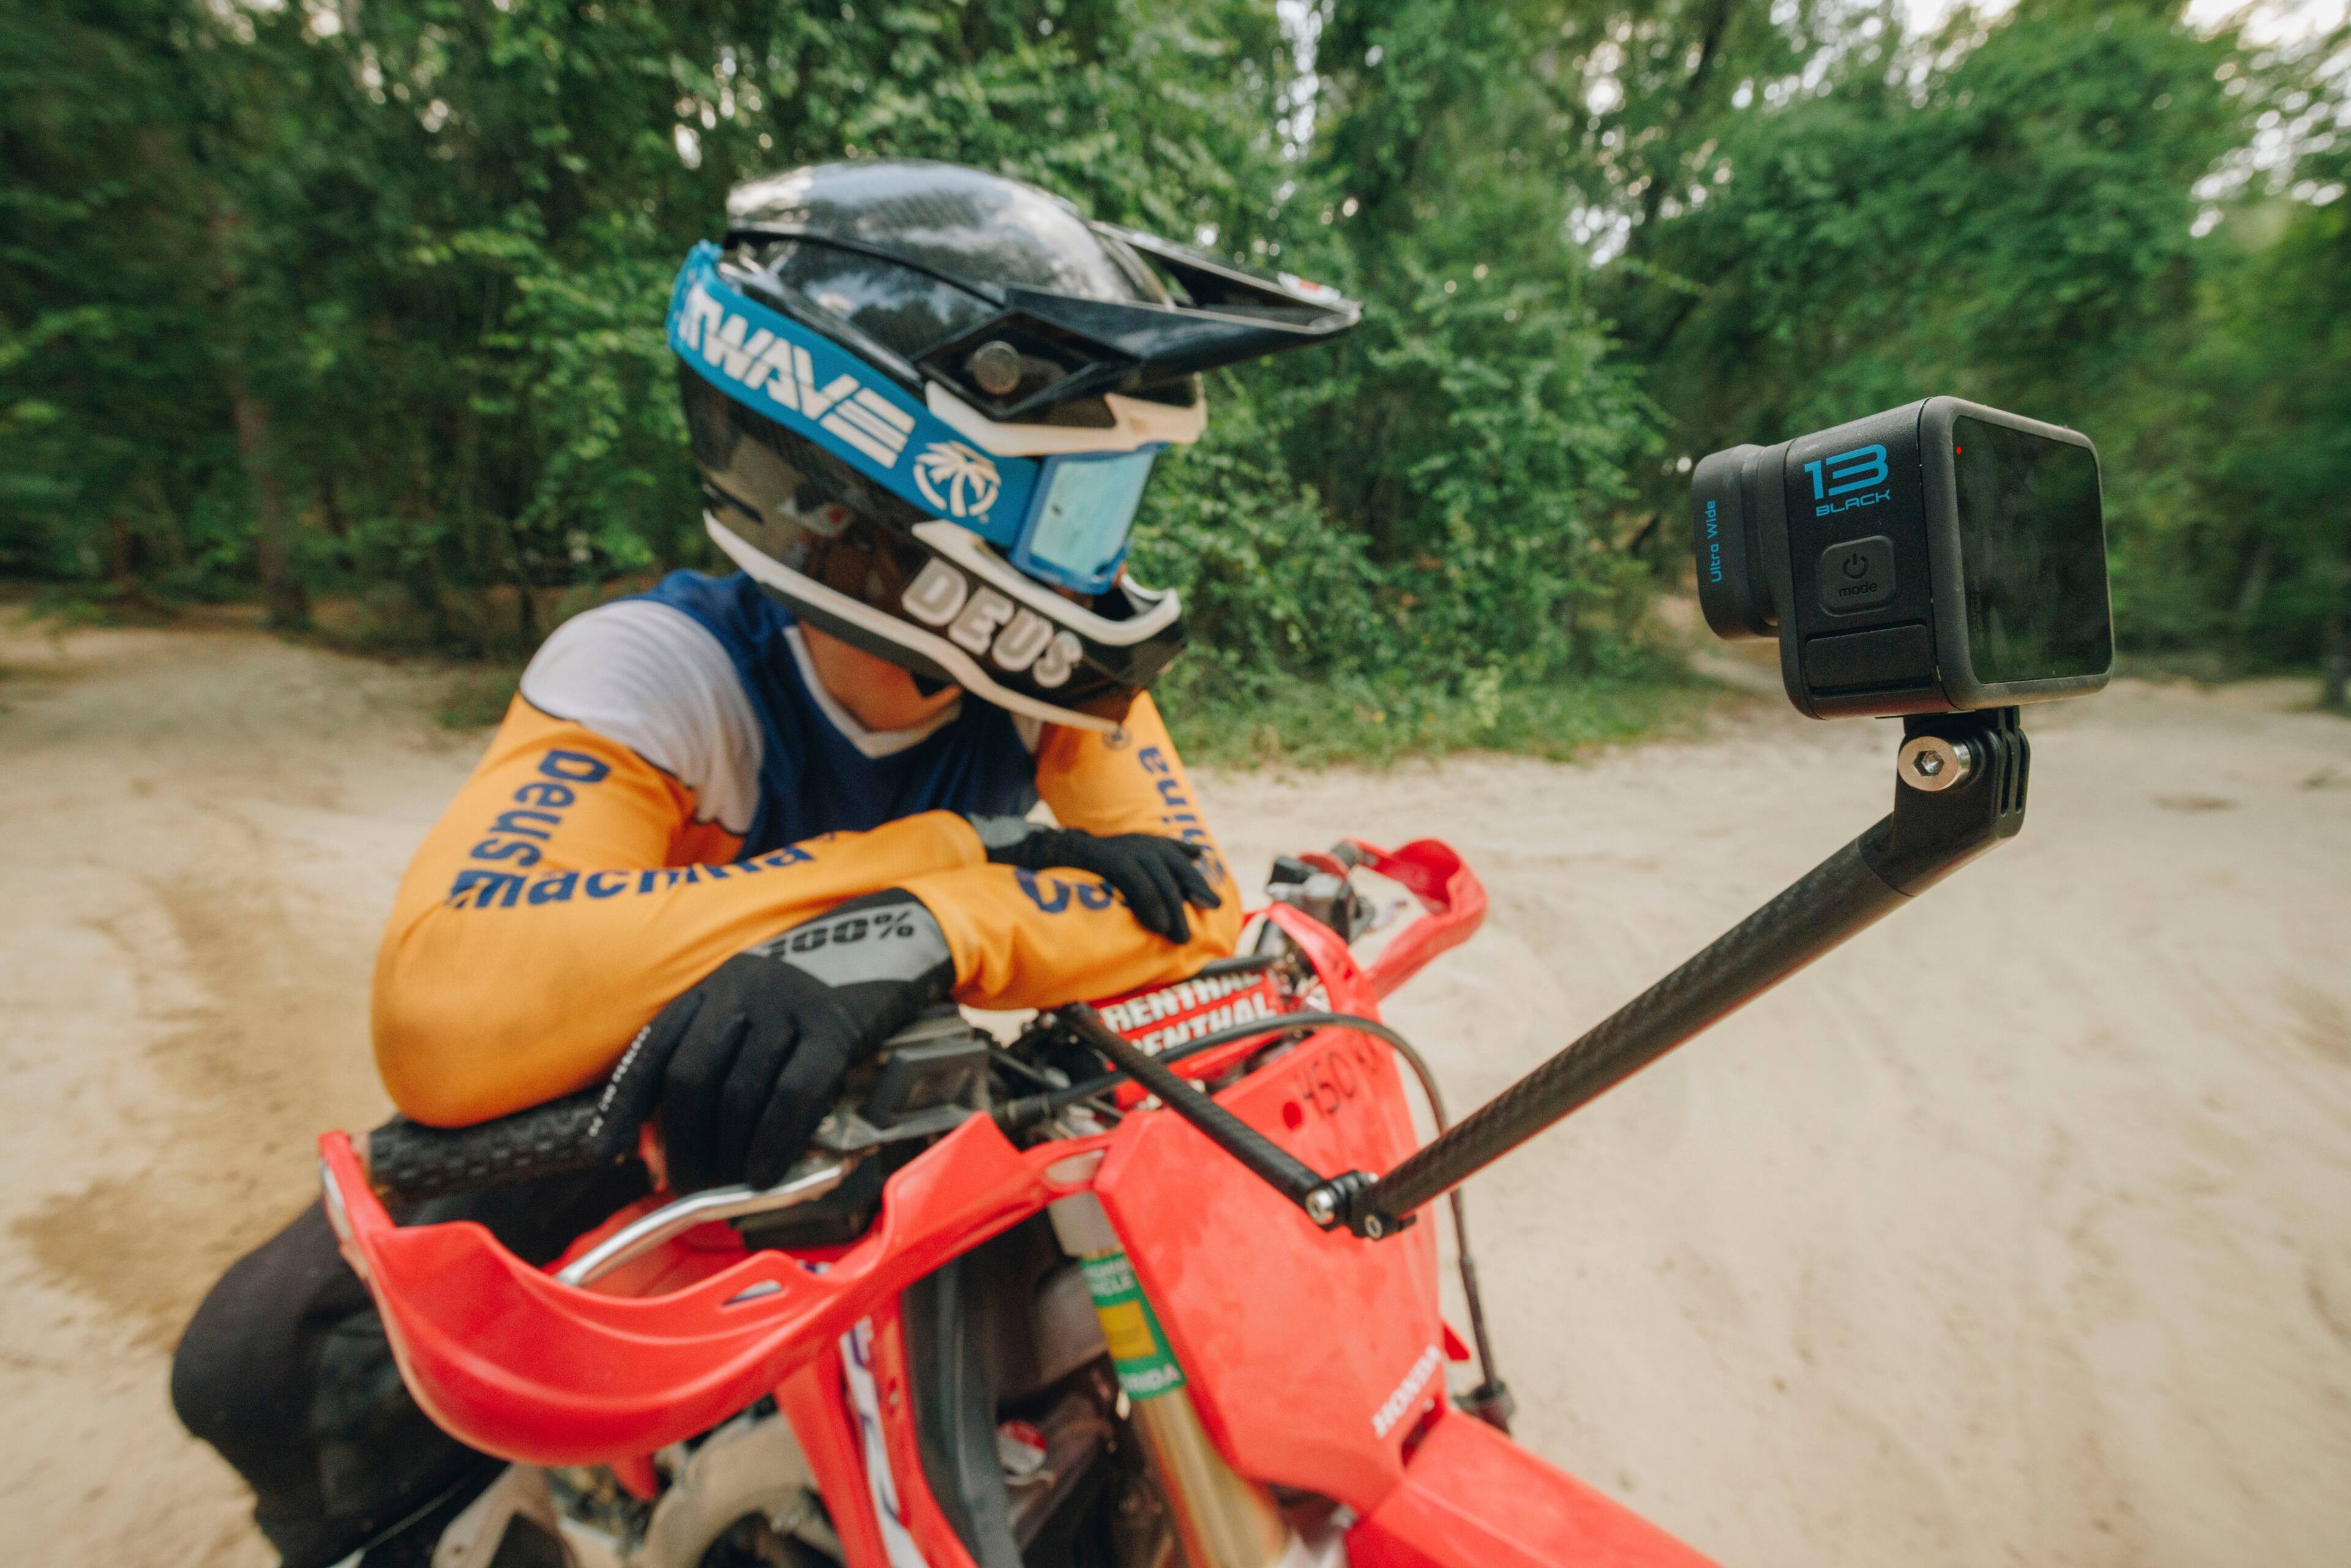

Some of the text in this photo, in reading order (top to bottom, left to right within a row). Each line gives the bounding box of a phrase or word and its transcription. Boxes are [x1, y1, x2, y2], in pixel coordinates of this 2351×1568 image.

[1804, 443, 1889, 500] 13
[1815, 489, 1891, 517] BLACK
[1704, 500, 1722, 583] Ultra Wide
[901, 556, 1084, 688] DEUS
[1838, 580, 1878, 598] mode
[469, 749, 611, 866] Deus
[1371, 1345, 1441, 1439] HONDA
